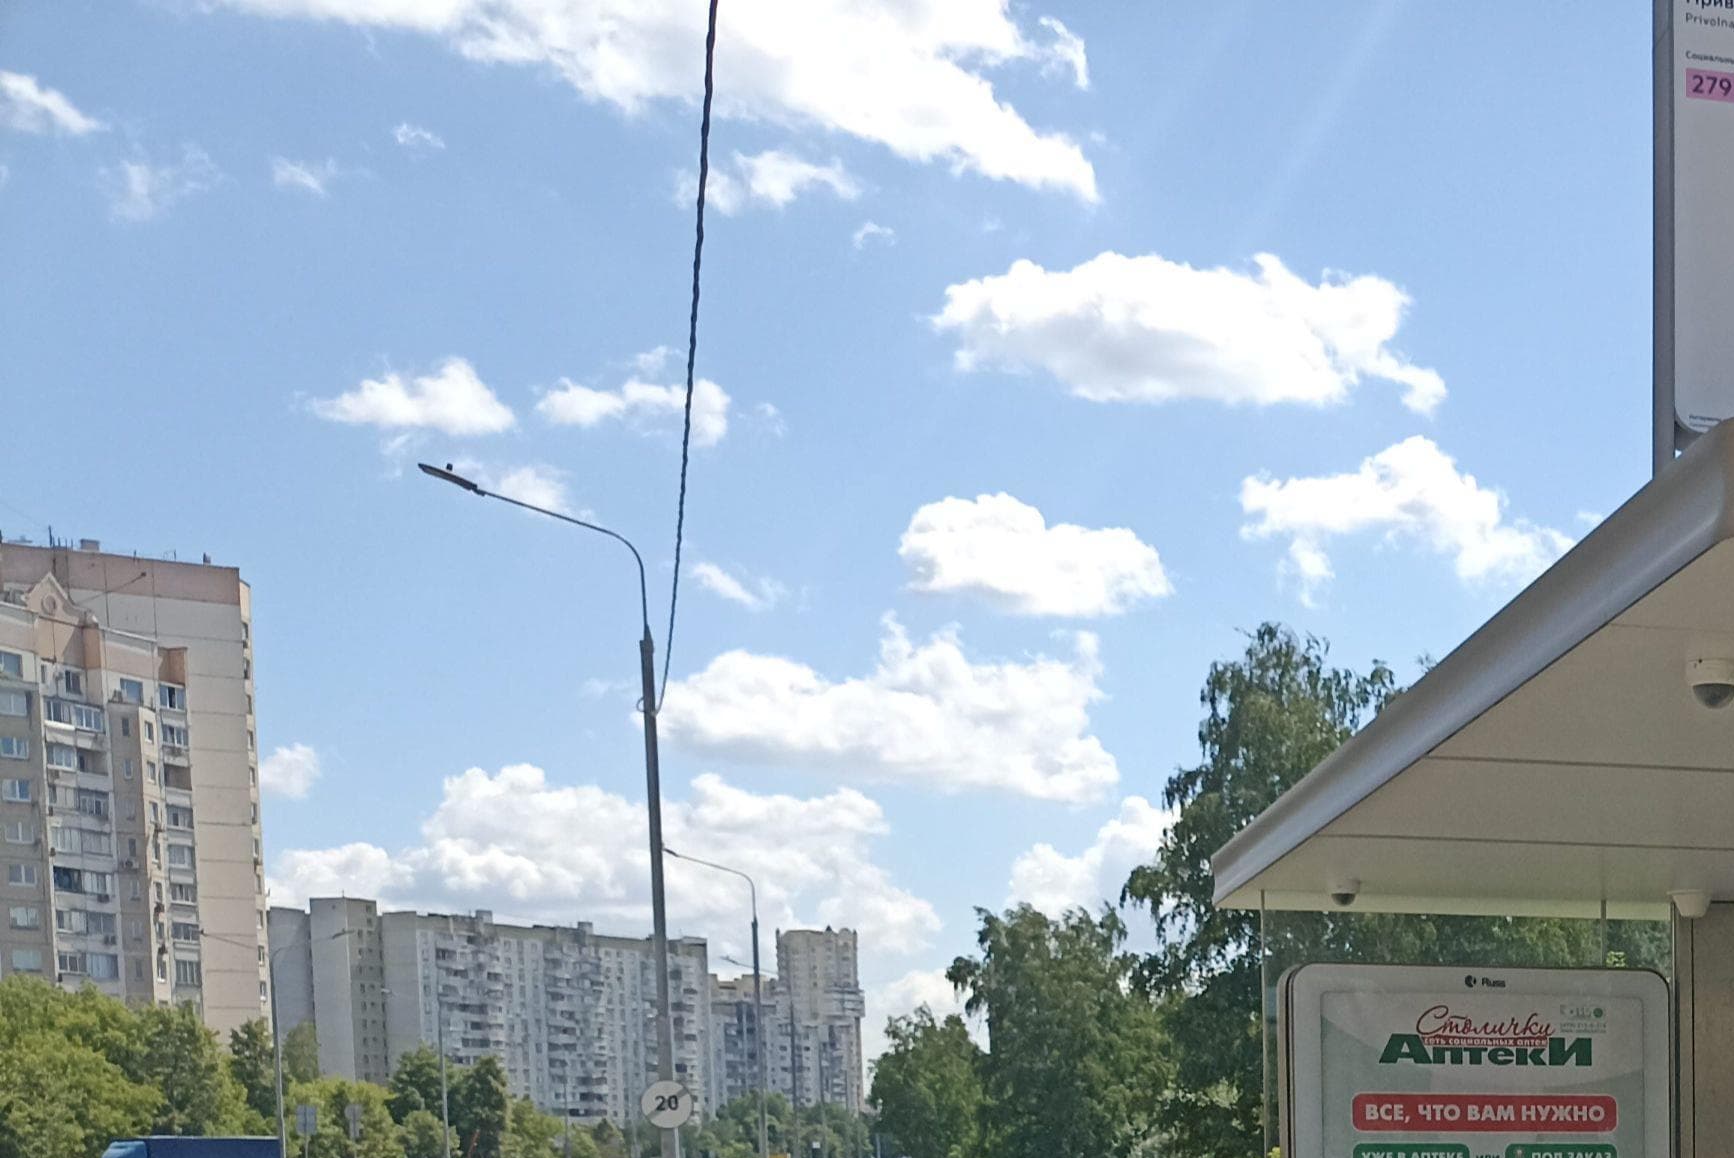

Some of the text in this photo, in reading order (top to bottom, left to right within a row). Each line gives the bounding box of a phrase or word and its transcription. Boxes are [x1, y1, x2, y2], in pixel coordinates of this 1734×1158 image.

[1692, 74, 1732, 97] 279
[1481, 976, 1506, 988] Russ
[1416, 1005, 1556, 1036] Столички
[655, 1095, 679, 1111] 20
[1365, 1103, 1606, 1124] ВСЕ, ЧТО ВАМ НУЖНО
